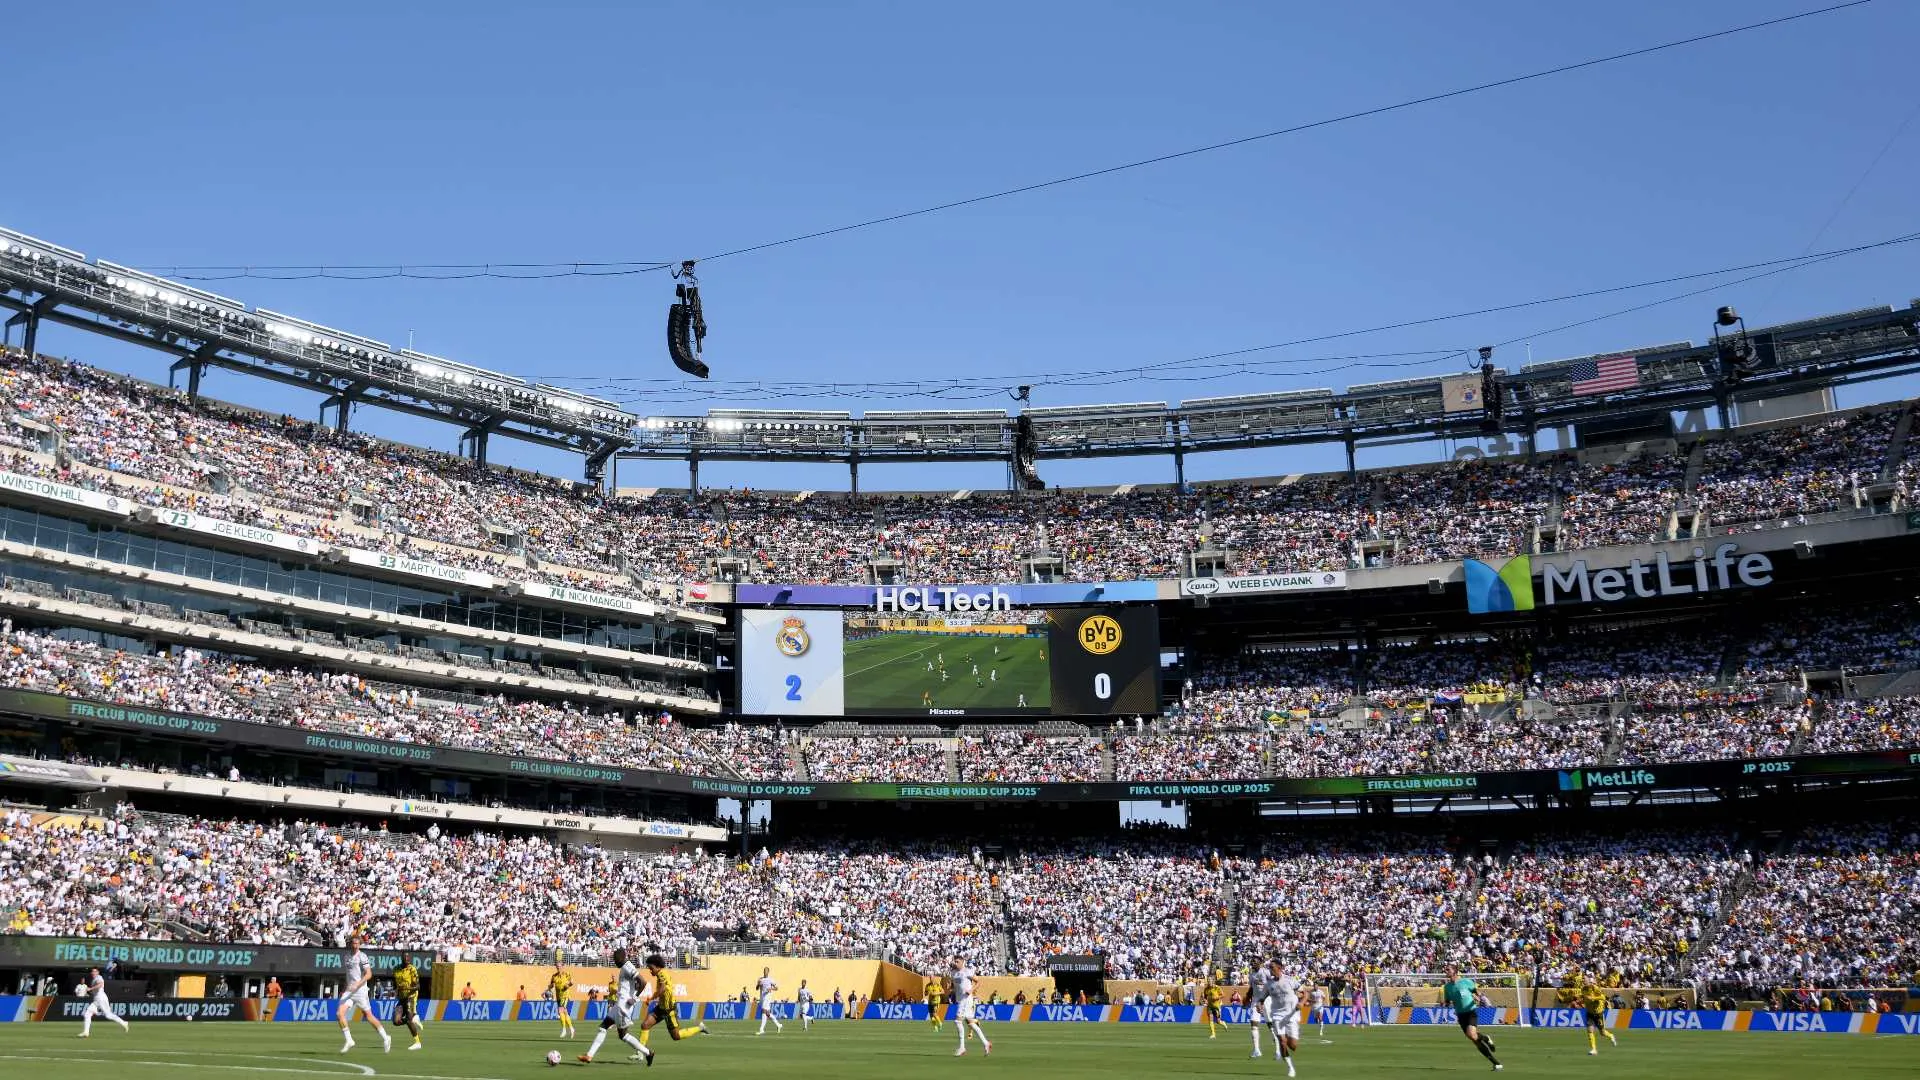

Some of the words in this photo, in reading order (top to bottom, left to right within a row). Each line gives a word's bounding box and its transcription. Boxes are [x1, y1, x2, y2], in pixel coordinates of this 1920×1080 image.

[0, 473, 58, 496] WINSTON
[171, 511, 189, 526] 73
[213, 521, 233, 534] JOE
[234, 525, 274, 542] KLECKO
[380, 555, 396, 568] 93
[401, 561, 437, 574] MARTY
[438, 568, 466, 580] LYONS
[1543, 542, 1773, 605] MetLife
[1228, 578, 1260, 589] WEEB
[1264, 576, 1313, 587] EWBANK
[549, 587, 565, 599] 74
[568, 591, 588, 602] NICK
[589, 595, 632, 609] MANGOLD
[876, 587, 1011, 611] HCLTech
[1085, 620, 1116, 642] BVB
[786, 675, 801, 700] 2
[1095, 673, 1111, 699] 0
[71, 703, 95, 717] FIFA
[96, 708, 125, 721] CLUB
[127, 712, 167, 726] WORLD
[168, 717, 189, 729] CUP
[191, 720, 217, 733] 2025
[306, 735, 327, 748] FIFA
[328, 739, 352, 750] CLUB
[354, 742, 388, 755] WORLD
[389, 747, 407, 757] CUP
[510, 760, 529, 771] FIFA
[530, 763, 551, 773] CLUB
[552, 765, 582, 777] WORLD
[583, 769, 600, 779] CUP
[1759, 762, 1791, 773] 2025
[692, 780, 709, 789] FIFA
[710, 781, 729, 791] CLUB
[765, 786, 785, 794] CUP
[1367, 780, 1391, 789] FIFA
[1393, 779, 1421, 788] CLUB
[1423, 778, 1464, 787] WORLD
[1586, 770, 1655, 787] MetLife
[901, 787, 921, 796] FIFA
[924, 787, 949, 796] CLUB
[951, 787, 988, 796] WORLD
[990, 787, 1009, 796] CUP
[1129, 786, 1151, 794] FIFA
[1153, 785, 1179, 794] CLUB
[1181, 784, 1219, 794] WORLD
[1221, 784, 1242, 793] CUP
[554, 818, 581, 828] verizon
[650, 823, 682, 835] HCLTech
[55, 943, 88, 960] FIFA
[91, 944, 129, 961] CLUB
[133, 947, 184, 963] WORLD
[186, 949, 214, 965] CUP
[217, 950, 252, 966] 2025
[315, 953, 342, 968] FIFA
[378, 955, 421, 969] WOD
[129, 1002, 173, 1016] WORLD
[175, 1003, 200, 1016] CUP
[201, 1003, 231, 1016] 2025
[289, 1000, 329, 1020] VISA
[458, 1002, 490, 1020] VISA
[530, 1002, 558, 1020] VISA
[712, 1003, 736, 1018] VISA
[770, 1003, 785, 1018] ISA
[812, 1003, 833, 1018] VISA
[878, 1004, 913, 1019] VISA
[976, 1005, 997, 1020] SA
[1042, 1005, 1084, 1021] VISA
[1133, 1005, 1176, 1021] VISA
[1425, 1008, 1459, 1024] VIS
[1535, 1008, 1586, 1026] VISA
[1647, 1011, 1702, 1029] VISA
[1767, 1012, 1827, 1031] VISA
[1894, 1014, 1920, 1033] VI
